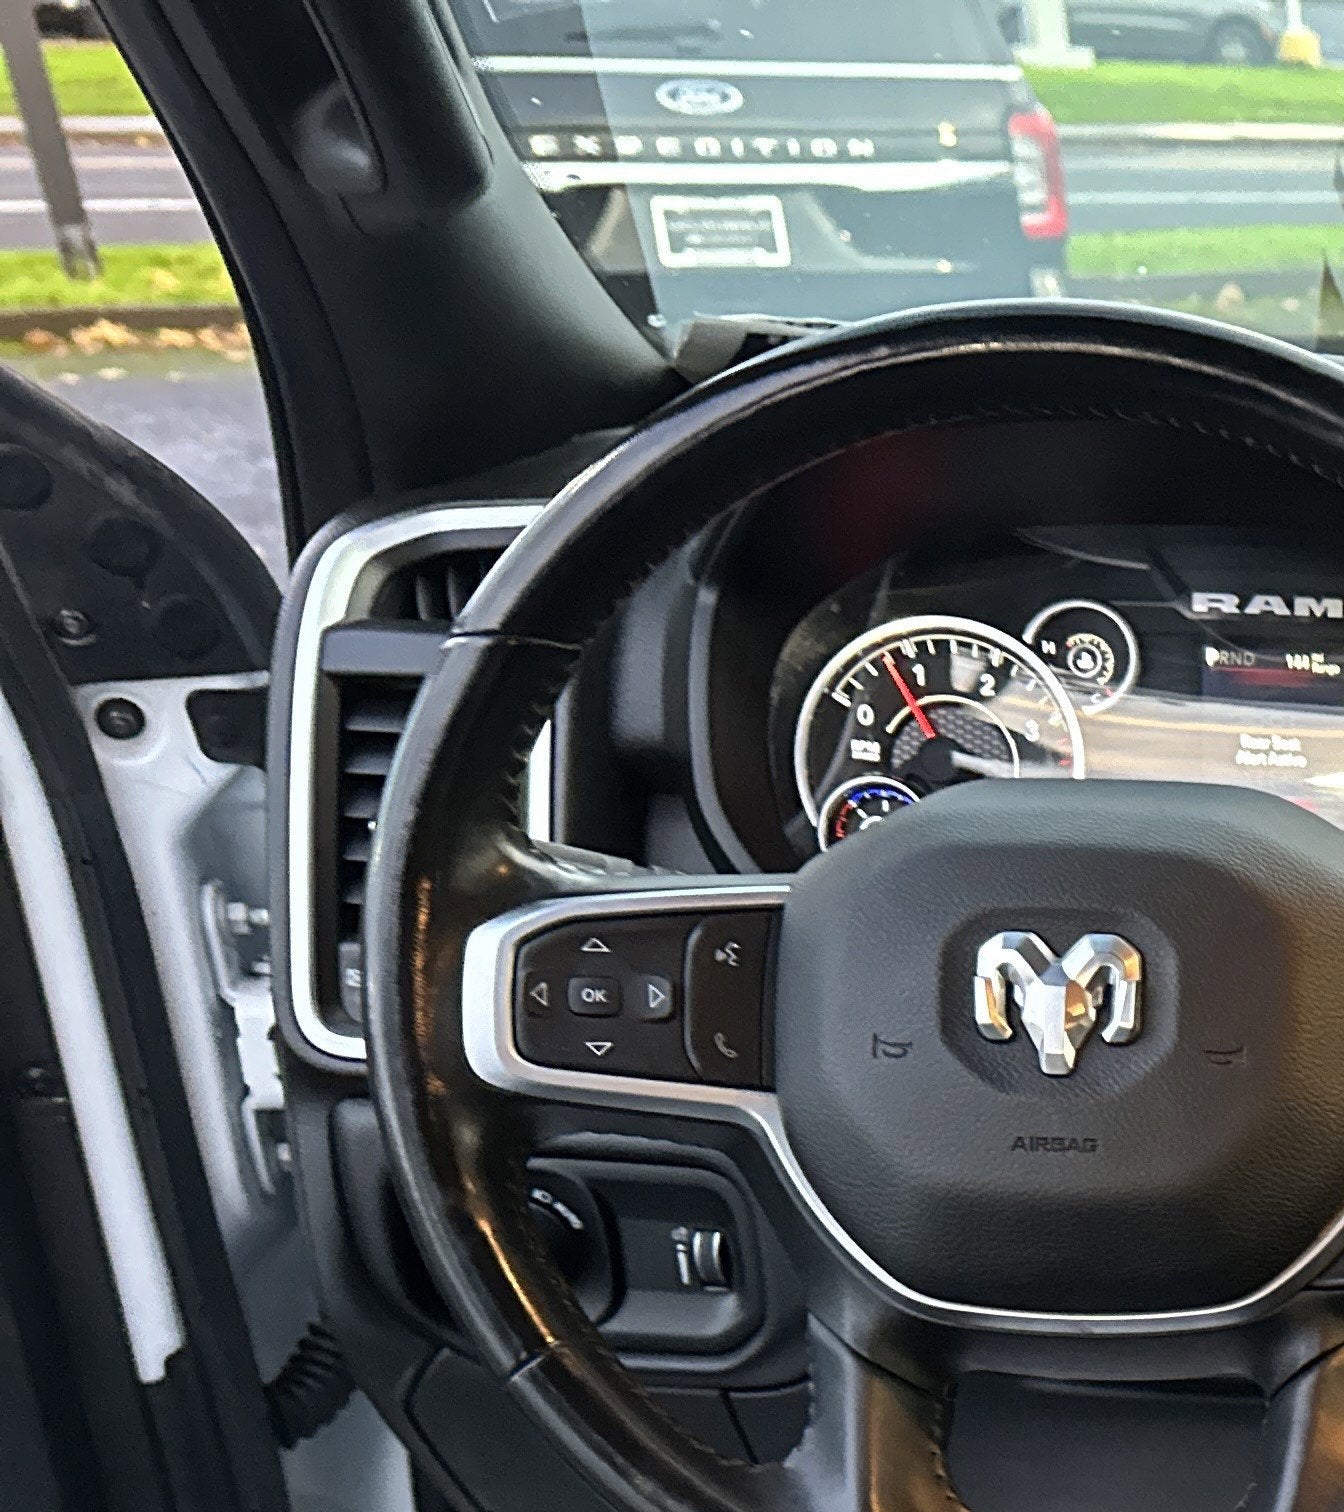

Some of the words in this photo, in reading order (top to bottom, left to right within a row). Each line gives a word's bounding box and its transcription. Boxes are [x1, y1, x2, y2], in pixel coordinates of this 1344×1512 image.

[528, 133, 876, 158] EXPEDITION
[1191, 592, 1344, 619] RAM
[912, 663, 926, 687] 1
[979, 673, 996, 698] 2
[856, 703, 875, 727] 0
[1025, 719, 1041, 742] 3
[581, 987, 607, 1003] OK
[1009, 1135, 1099, 1153] AIRBAG
